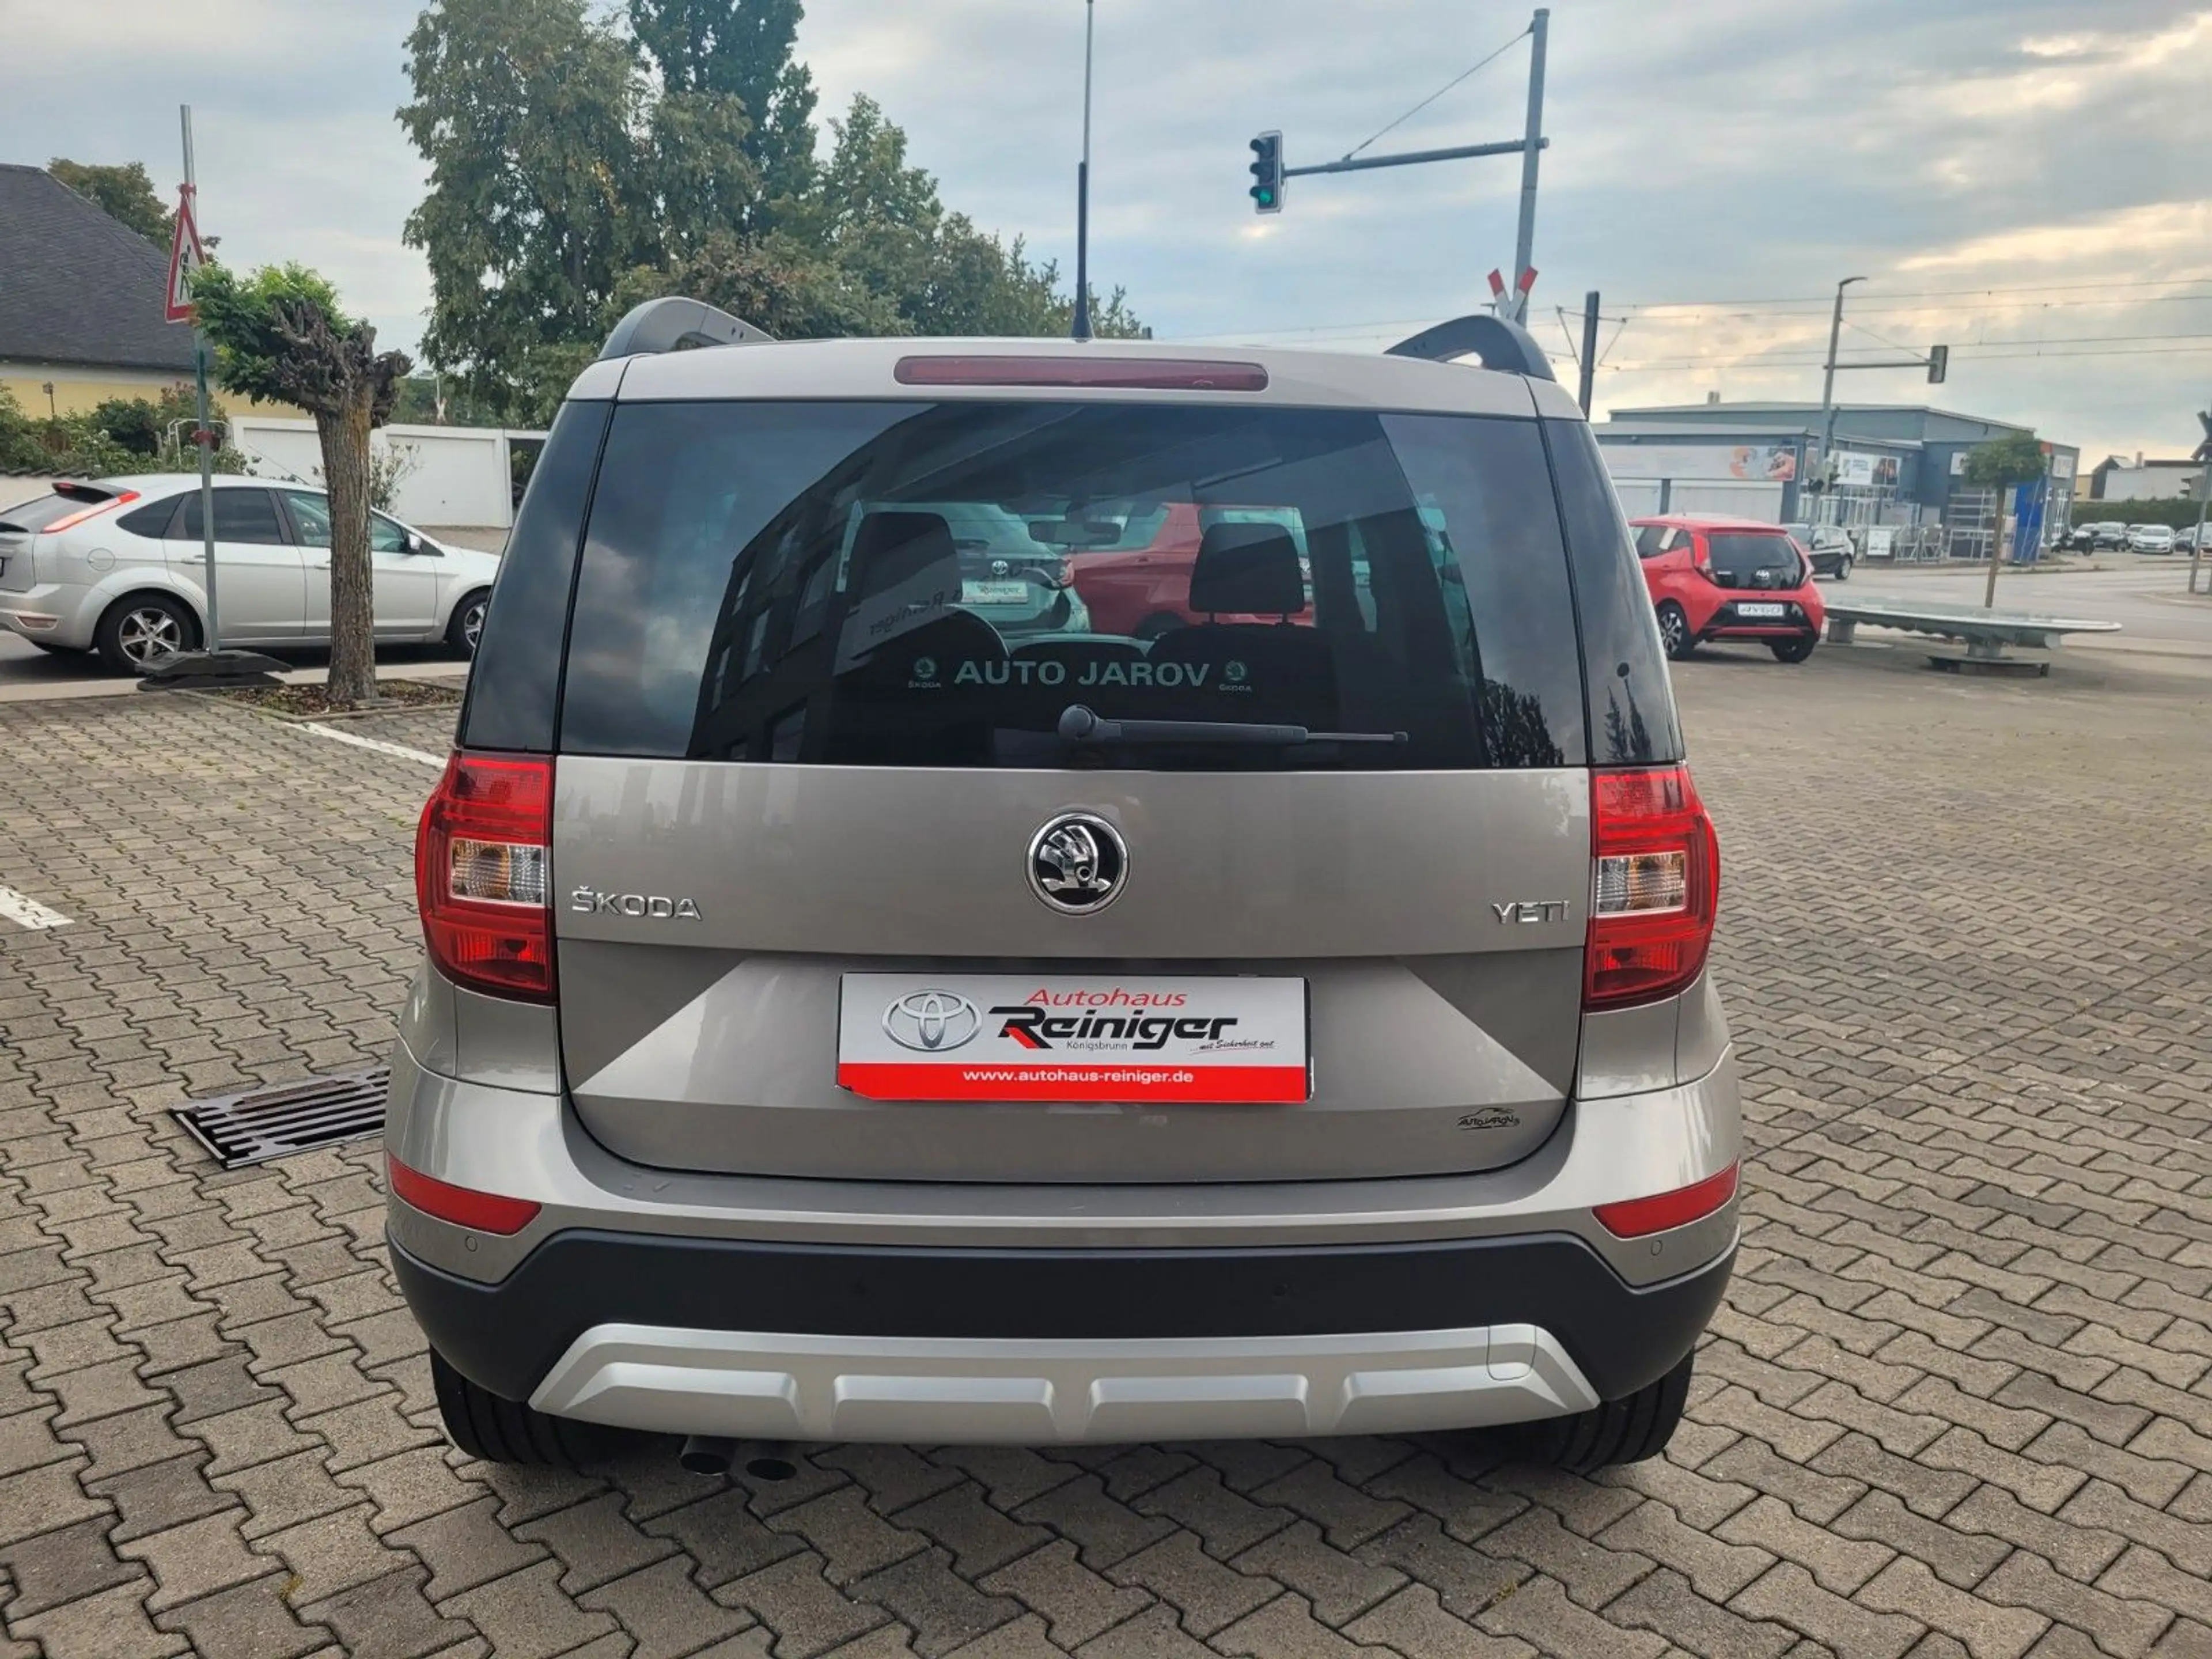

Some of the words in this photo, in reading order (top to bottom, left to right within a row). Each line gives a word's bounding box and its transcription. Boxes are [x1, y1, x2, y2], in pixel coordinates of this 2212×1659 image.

[954, 661, 1066, 685] AUTO
[1078, 662, 1210, 687] JAROV
[571, 885, 702, 921] ŠKODA
[1492, 900, 1570, 924] YETI
[1023, 987, 1187, 1006] Autohaus
[988, 1006, 1238, 1050] Reiniger
[1066, 1039, 1127, 1051] Königsbrunn
[1215, 1039, 1258, 1050] Sicherheit
[963, 1069, 1194, 1085] www.autohaus-reiniger.de
